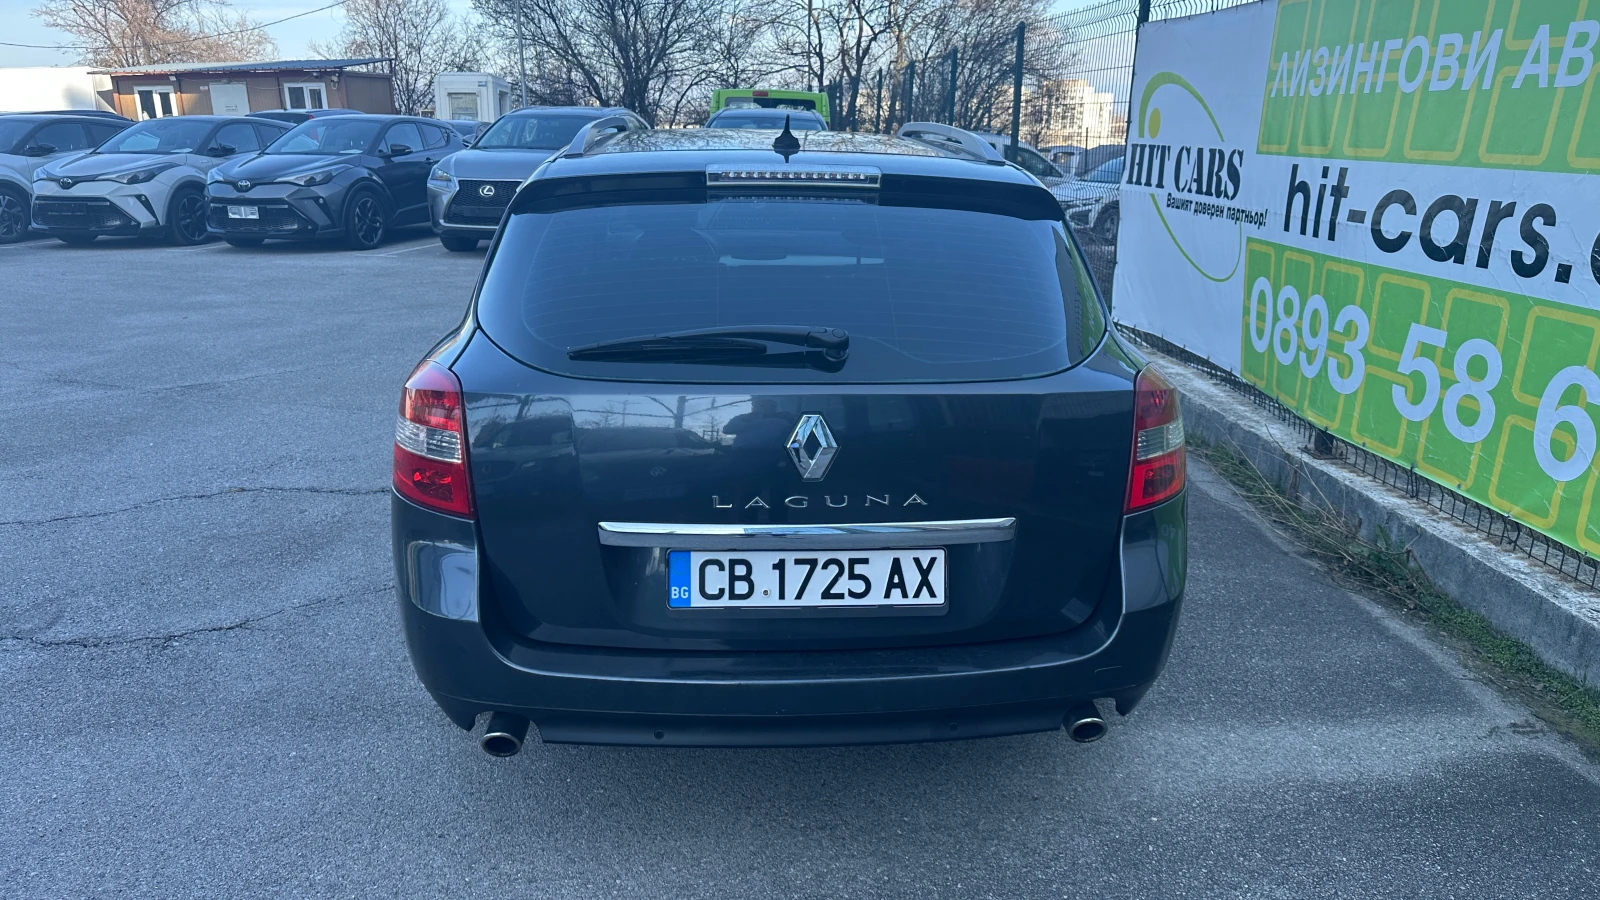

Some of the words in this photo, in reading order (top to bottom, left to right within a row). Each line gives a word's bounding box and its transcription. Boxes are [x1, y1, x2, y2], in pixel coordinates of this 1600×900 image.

[1270, 28, 1503, 98] ЛИЗИНГОВИ
[1126, 143, 1171, 189] HIT
[1174, 145, 1244, 201] CARS
[1166, 192, 1193, 213] Вашият
[1193, 201, 1225, 220] доверен
[1226, 206, 1269, 230] партньор!
[1283, 163, 1600, 286] hit-cars.
[1249, 276, 1370, 395] 0893
[1391, 322, 1503, 444] 58
[1533, 365, 1600, 482] 6
[711, 493, 929, 510] LAGUNA
[671, 586, 689, 599] BG
[698, 558, 755, 601] CB
[772, 557, 872, 601] 1725
[883, 556, 938, 600] AX
